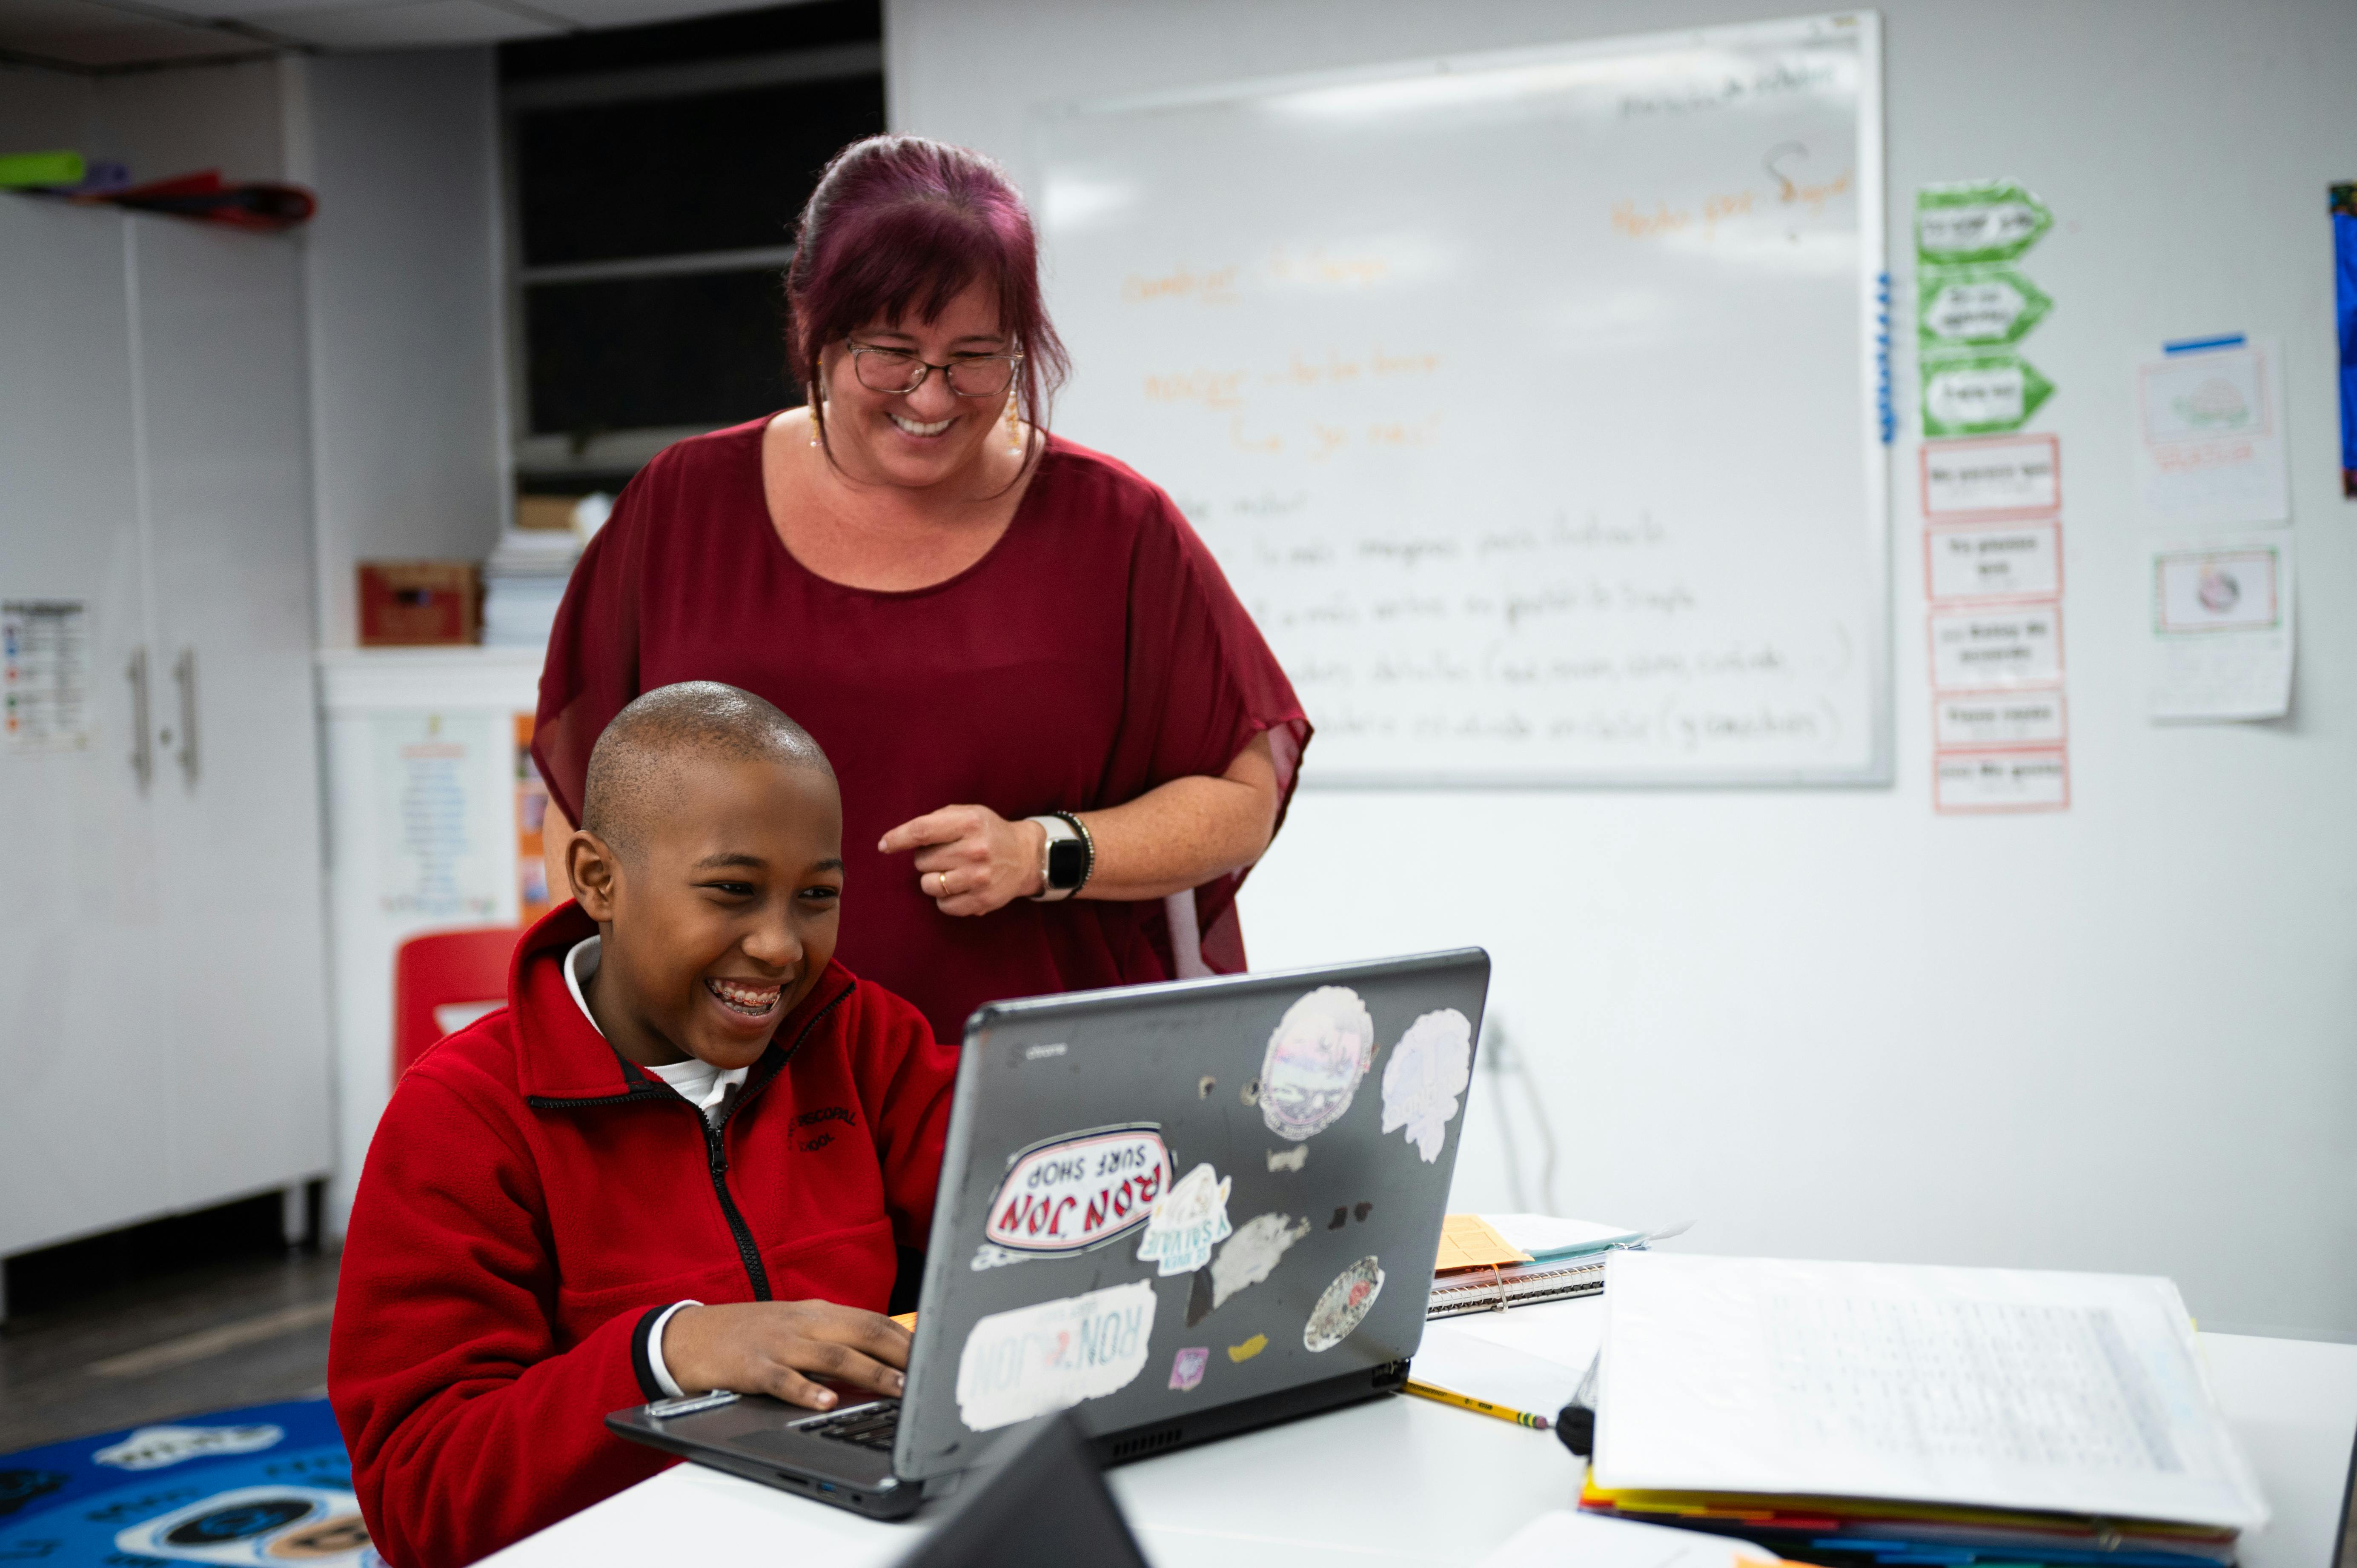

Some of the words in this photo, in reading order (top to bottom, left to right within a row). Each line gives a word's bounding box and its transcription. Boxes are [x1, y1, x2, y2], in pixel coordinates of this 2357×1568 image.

[1026, 1157, 1086, 1190] SHOP
[1095, 1144, 1147, 1179] SURF
[998, 1194, 1078, 1236] JON
[1084, 1162, 1161, 1234] RON
[1077, 1305, 1143, 1371] RON
